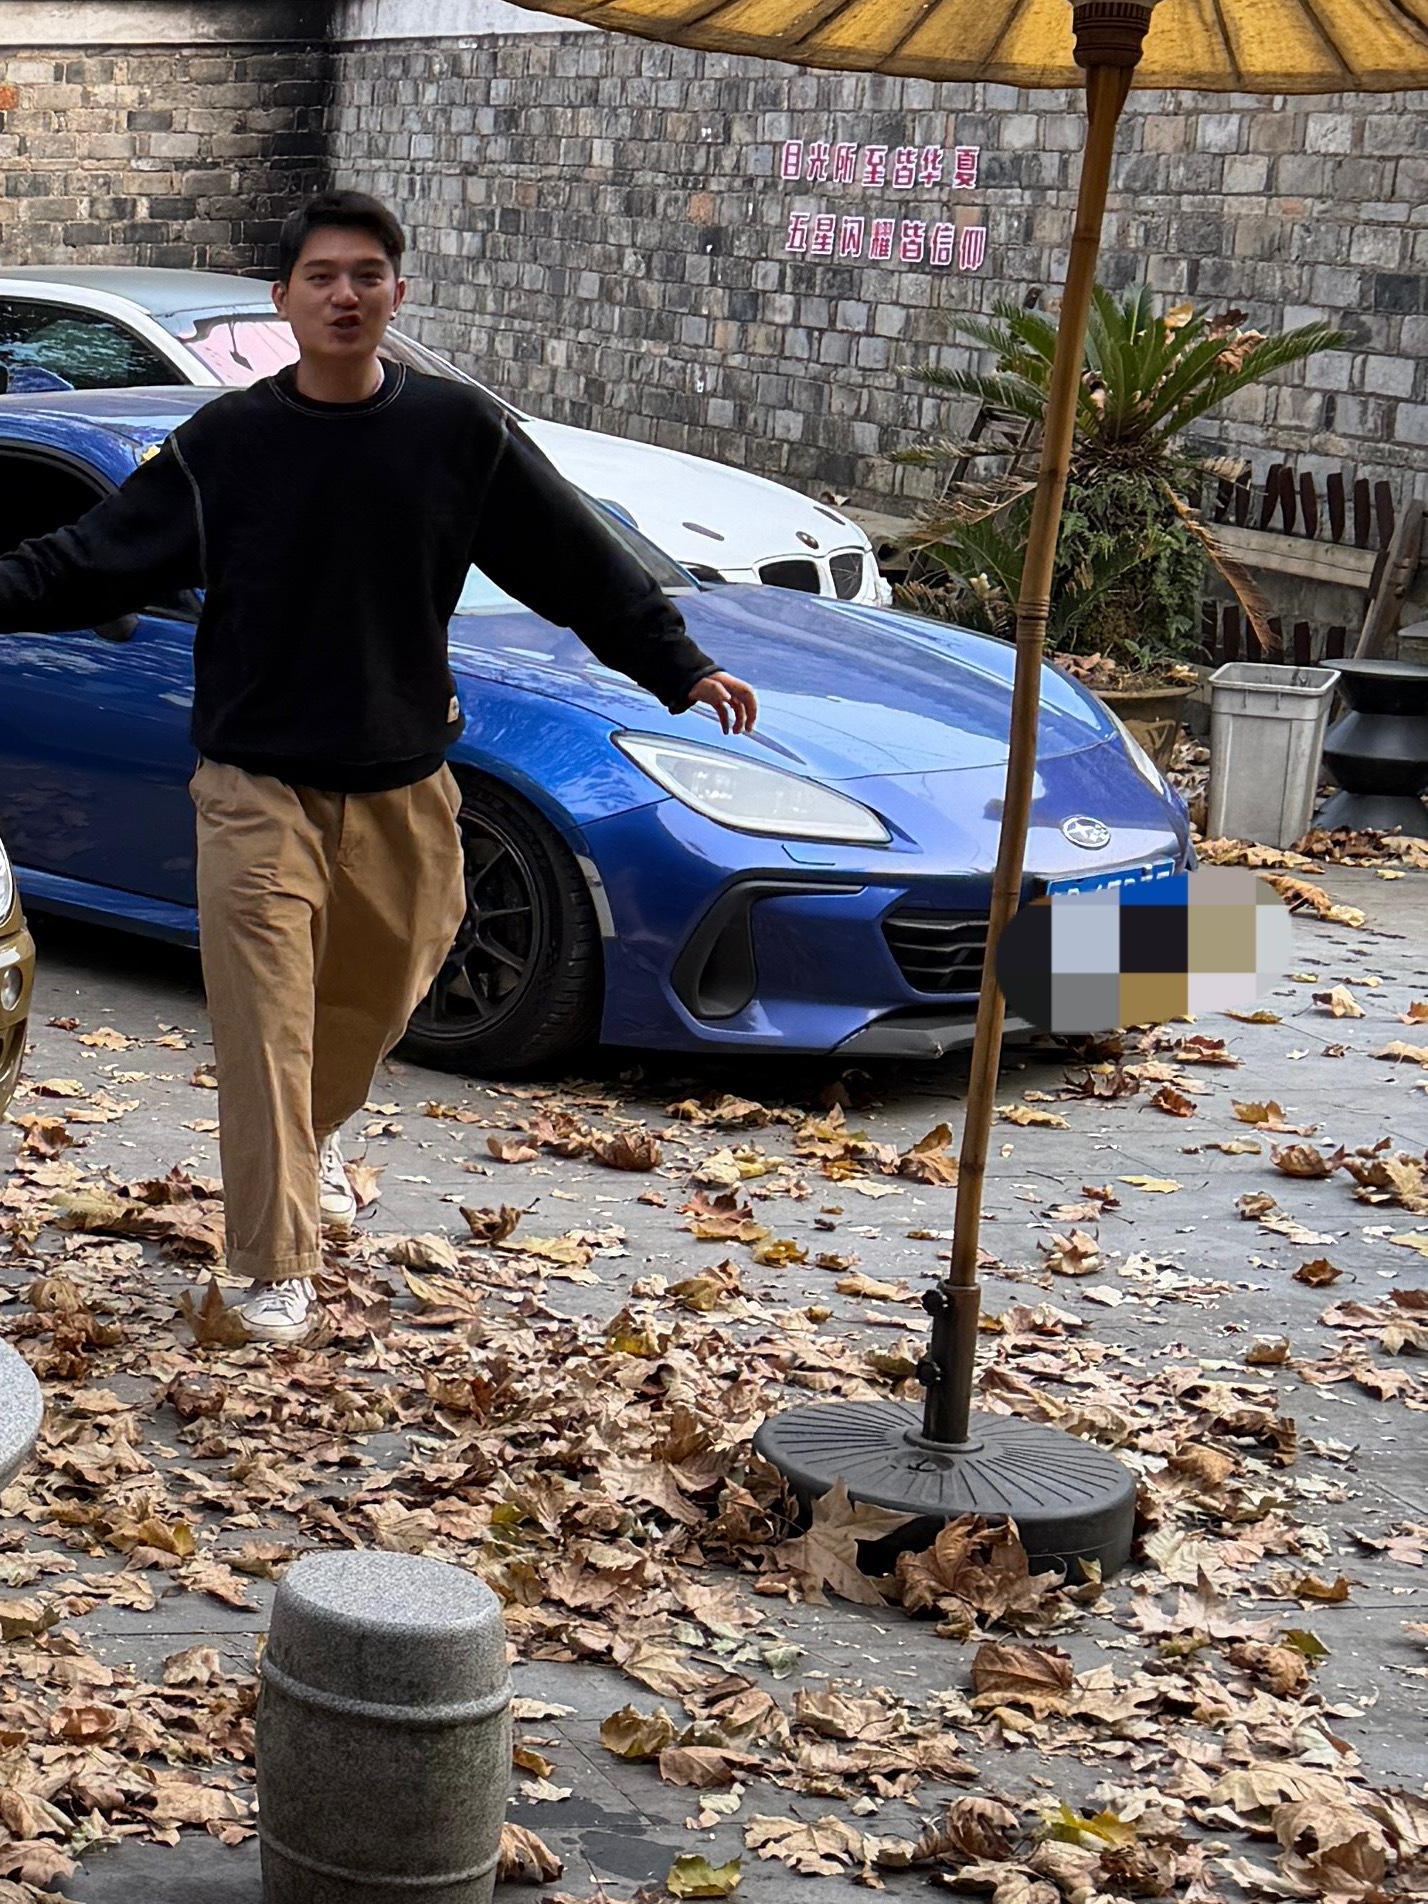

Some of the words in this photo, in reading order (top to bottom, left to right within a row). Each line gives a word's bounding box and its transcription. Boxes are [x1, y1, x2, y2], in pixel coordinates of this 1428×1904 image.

[781, 140, 980, 189] 目光所至皆华夏
[785, 212, 987, 270] 五星闪耀皆信仰
